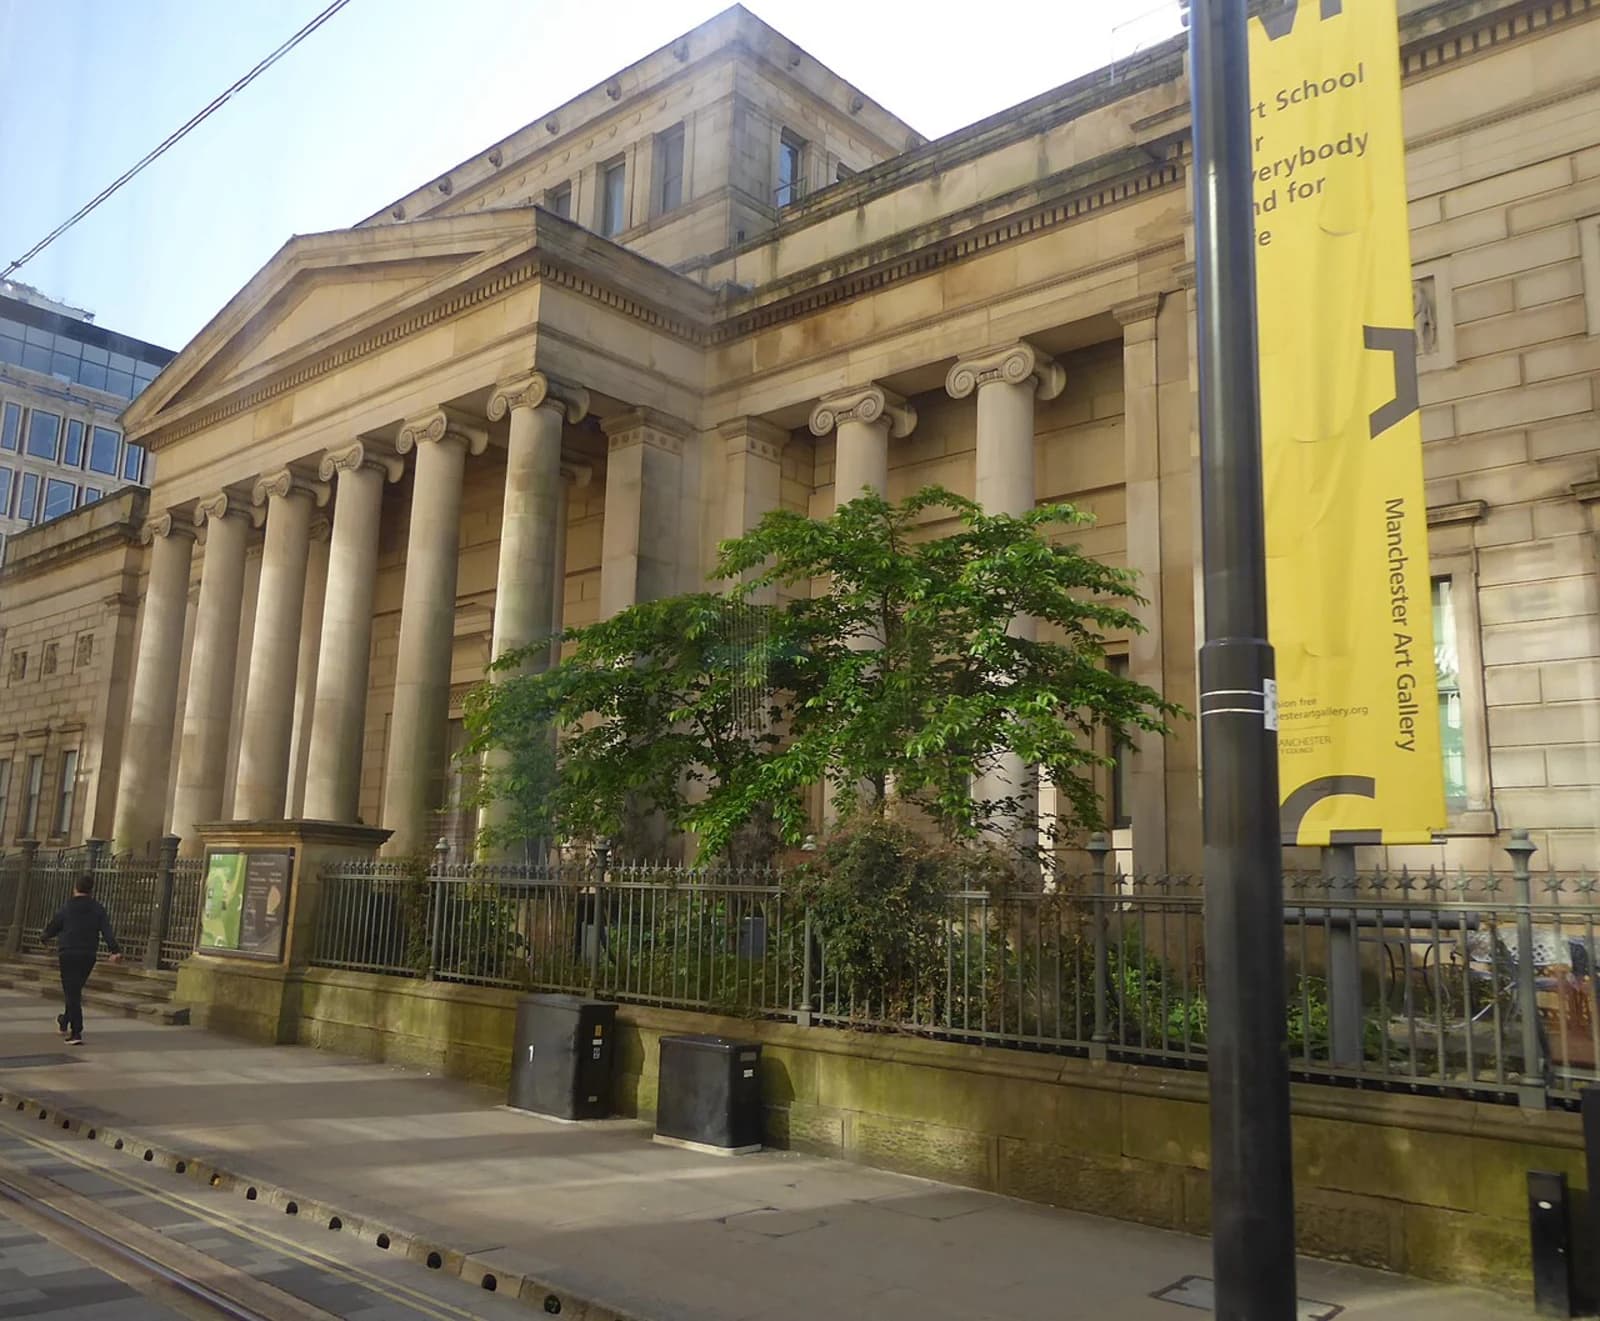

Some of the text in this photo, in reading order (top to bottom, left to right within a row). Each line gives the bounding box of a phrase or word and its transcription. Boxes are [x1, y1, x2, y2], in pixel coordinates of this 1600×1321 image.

[1276, 62, 1365, 111] School
[1252, 132, 1369, 182] erybody
[1252, 177, 1326, 216] nd for
[1385, 498, 1419, 752] Manchester Art Gallery
[1278, 706, 1369, 721] esterartgallery.org
